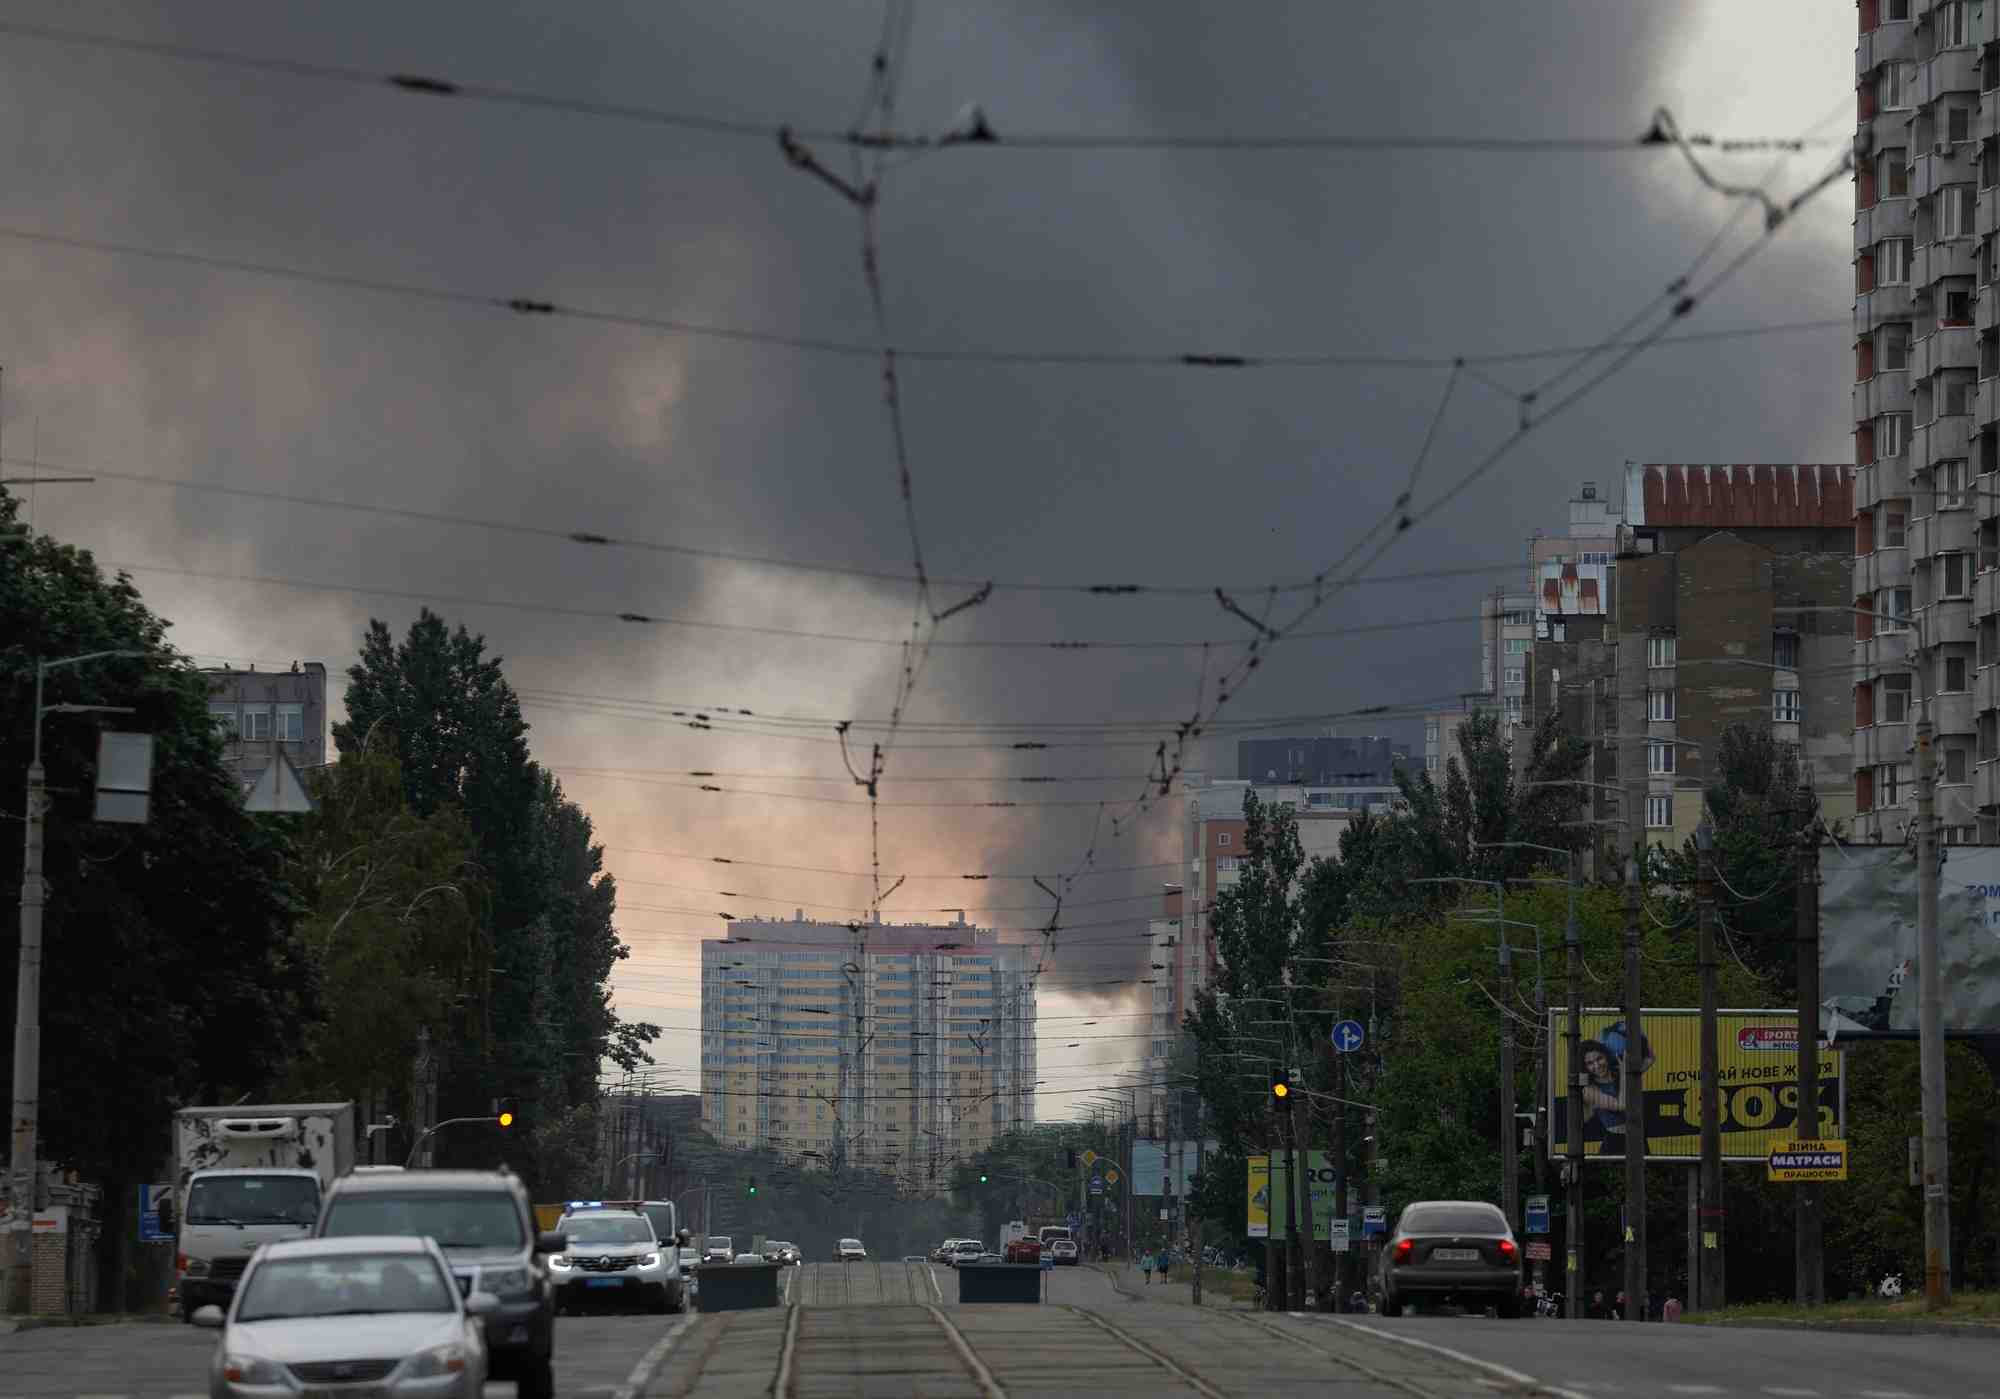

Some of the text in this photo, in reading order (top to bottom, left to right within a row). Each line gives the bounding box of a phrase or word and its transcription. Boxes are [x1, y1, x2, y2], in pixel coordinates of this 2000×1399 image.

[1742, 1065, 1779, 1079] НОВЕ
[1659, 1085, 1835, 1129] -80%
[1771, 1155, 1841, 1166] МАТРАСИ
